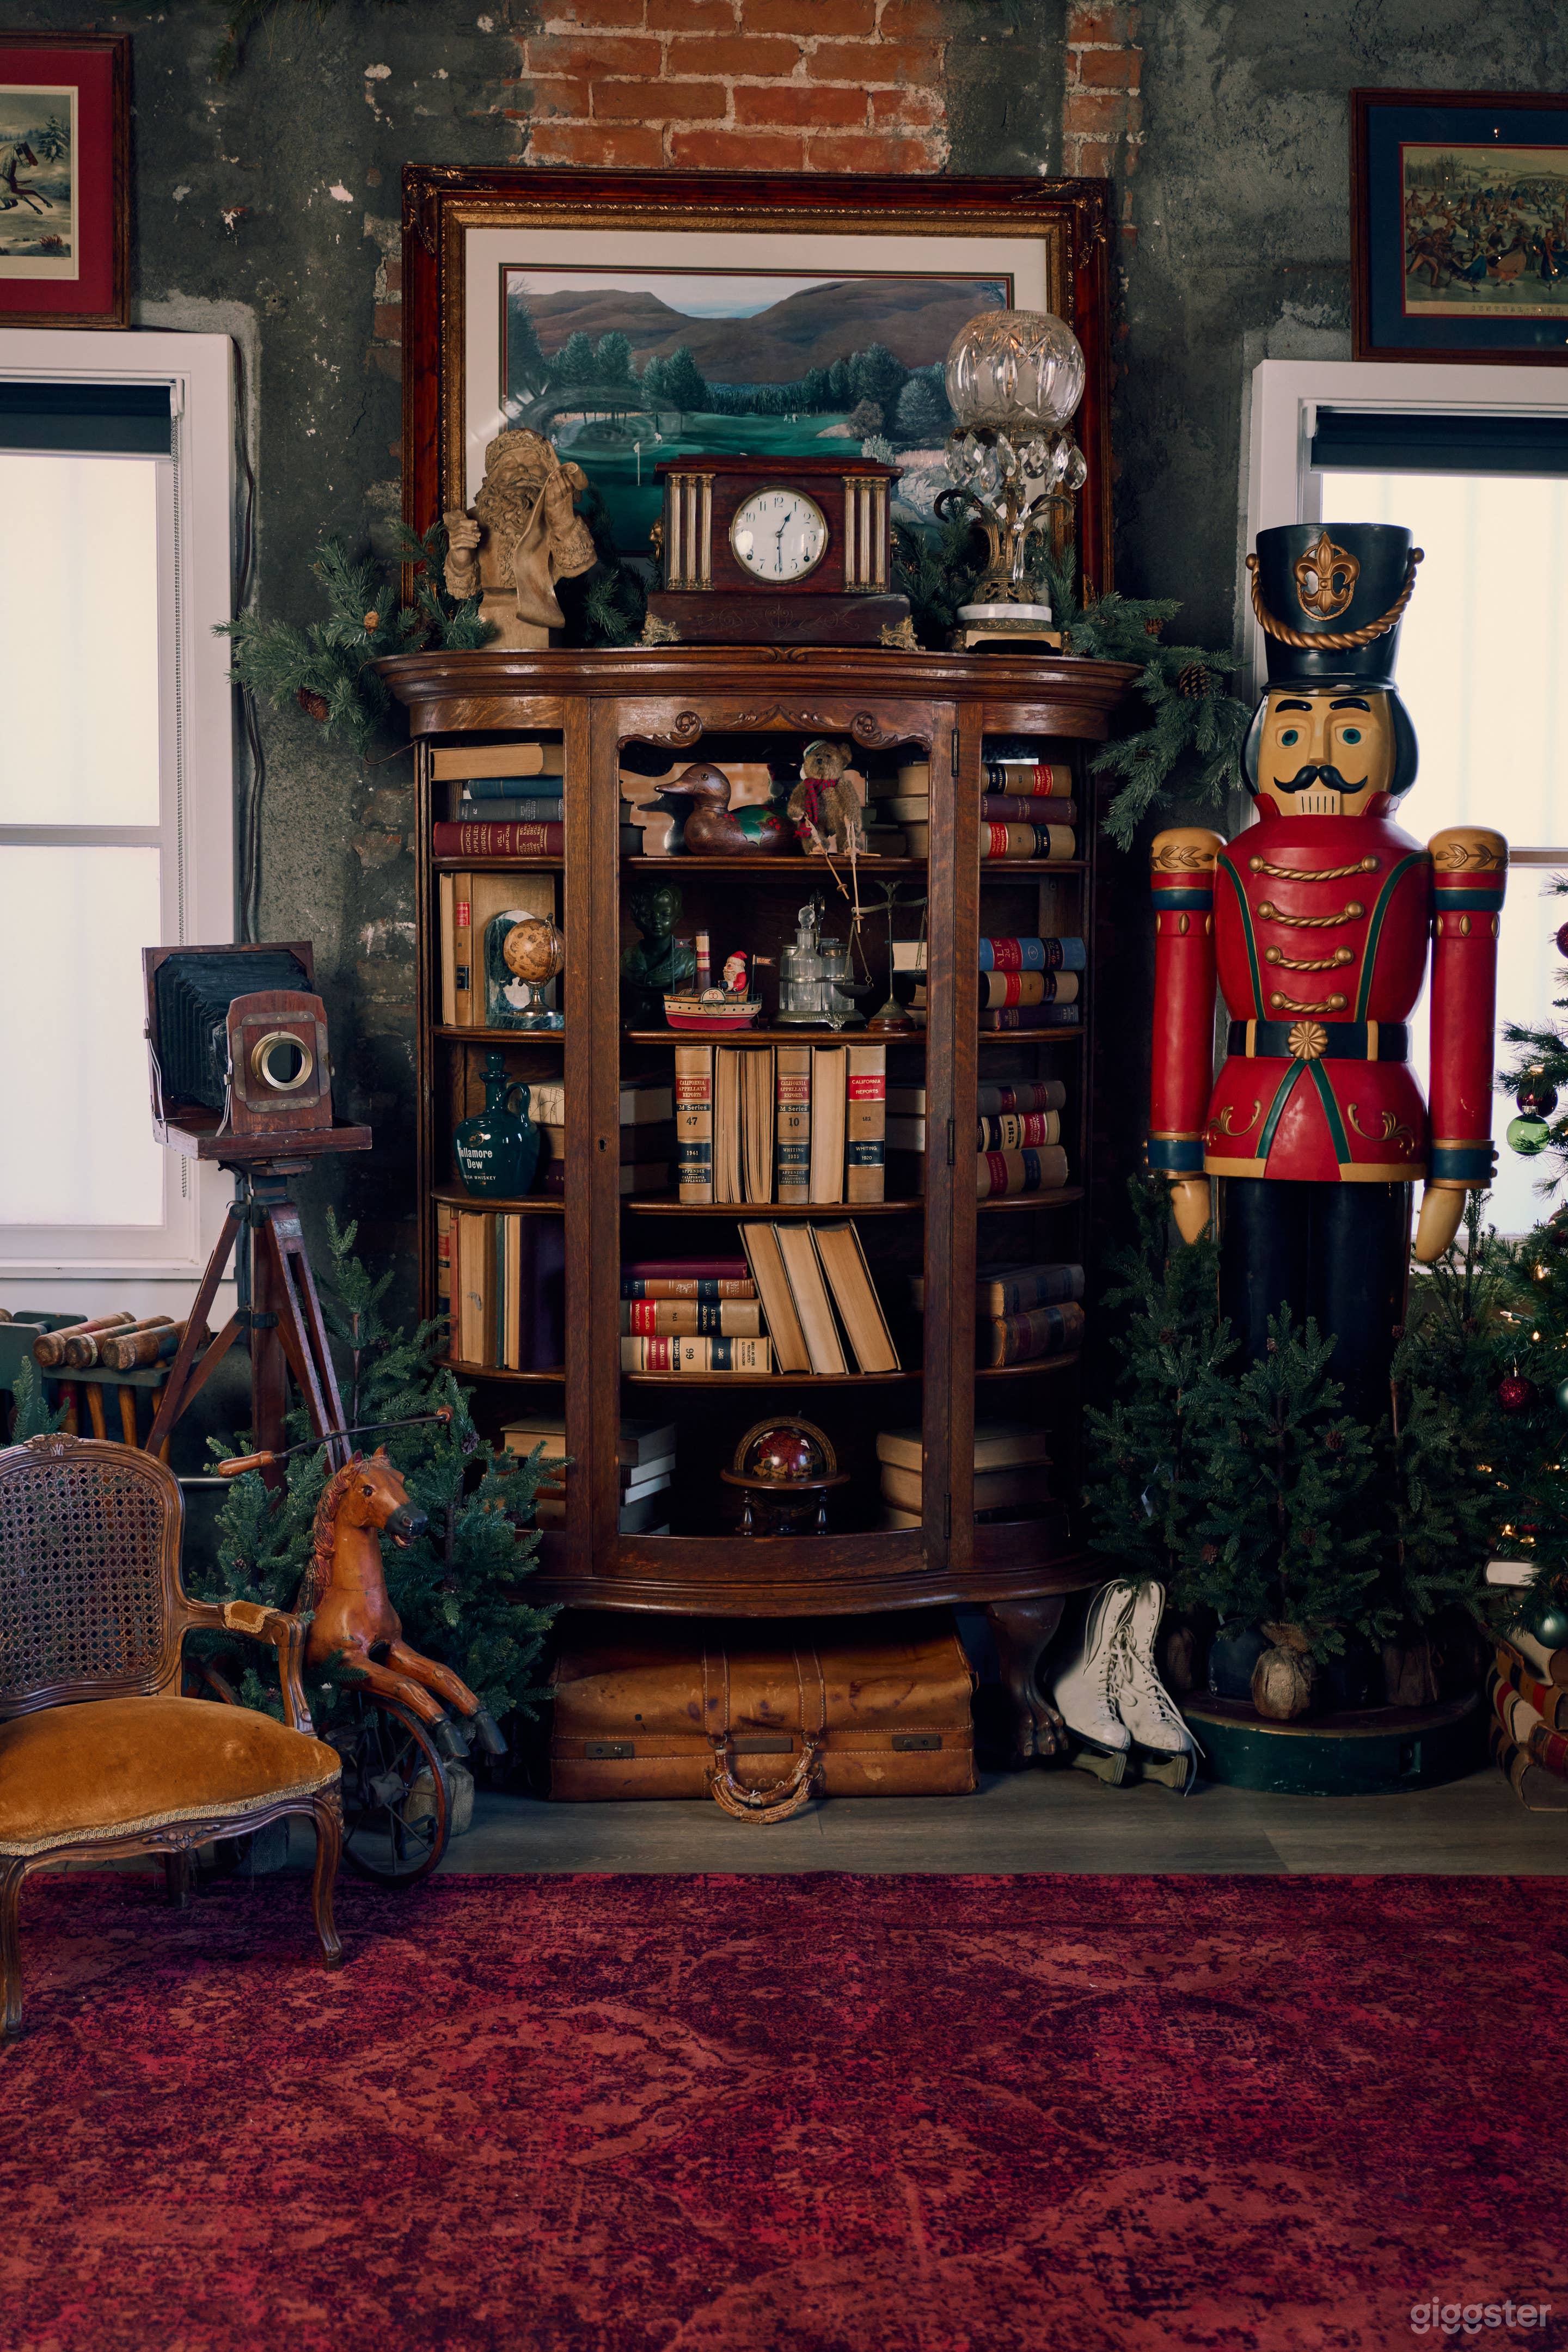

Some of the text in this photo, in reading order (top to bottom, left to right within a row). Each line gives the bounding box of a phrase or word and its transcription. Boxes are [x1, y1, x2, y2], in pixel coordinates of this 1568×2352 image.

[759, 501, 766, 511] 11
[774, 497, 783, 508] 12
[794, 501, 797, 512] 1
[746, 512, 755, 523] 10
[804, 513, 811, 524] 2
[1004, 948, 1010, 958] 2d
[686, 1117, 697, 1125] 47
[788, 1117, 799, 1126] 10
[458, 1147, 493, 1158] Tullamore
[467, 1159, 482, 1169] Dew
[632, 1281, 640, 1297] Today
[686, 1348, 694, 1359] 66
